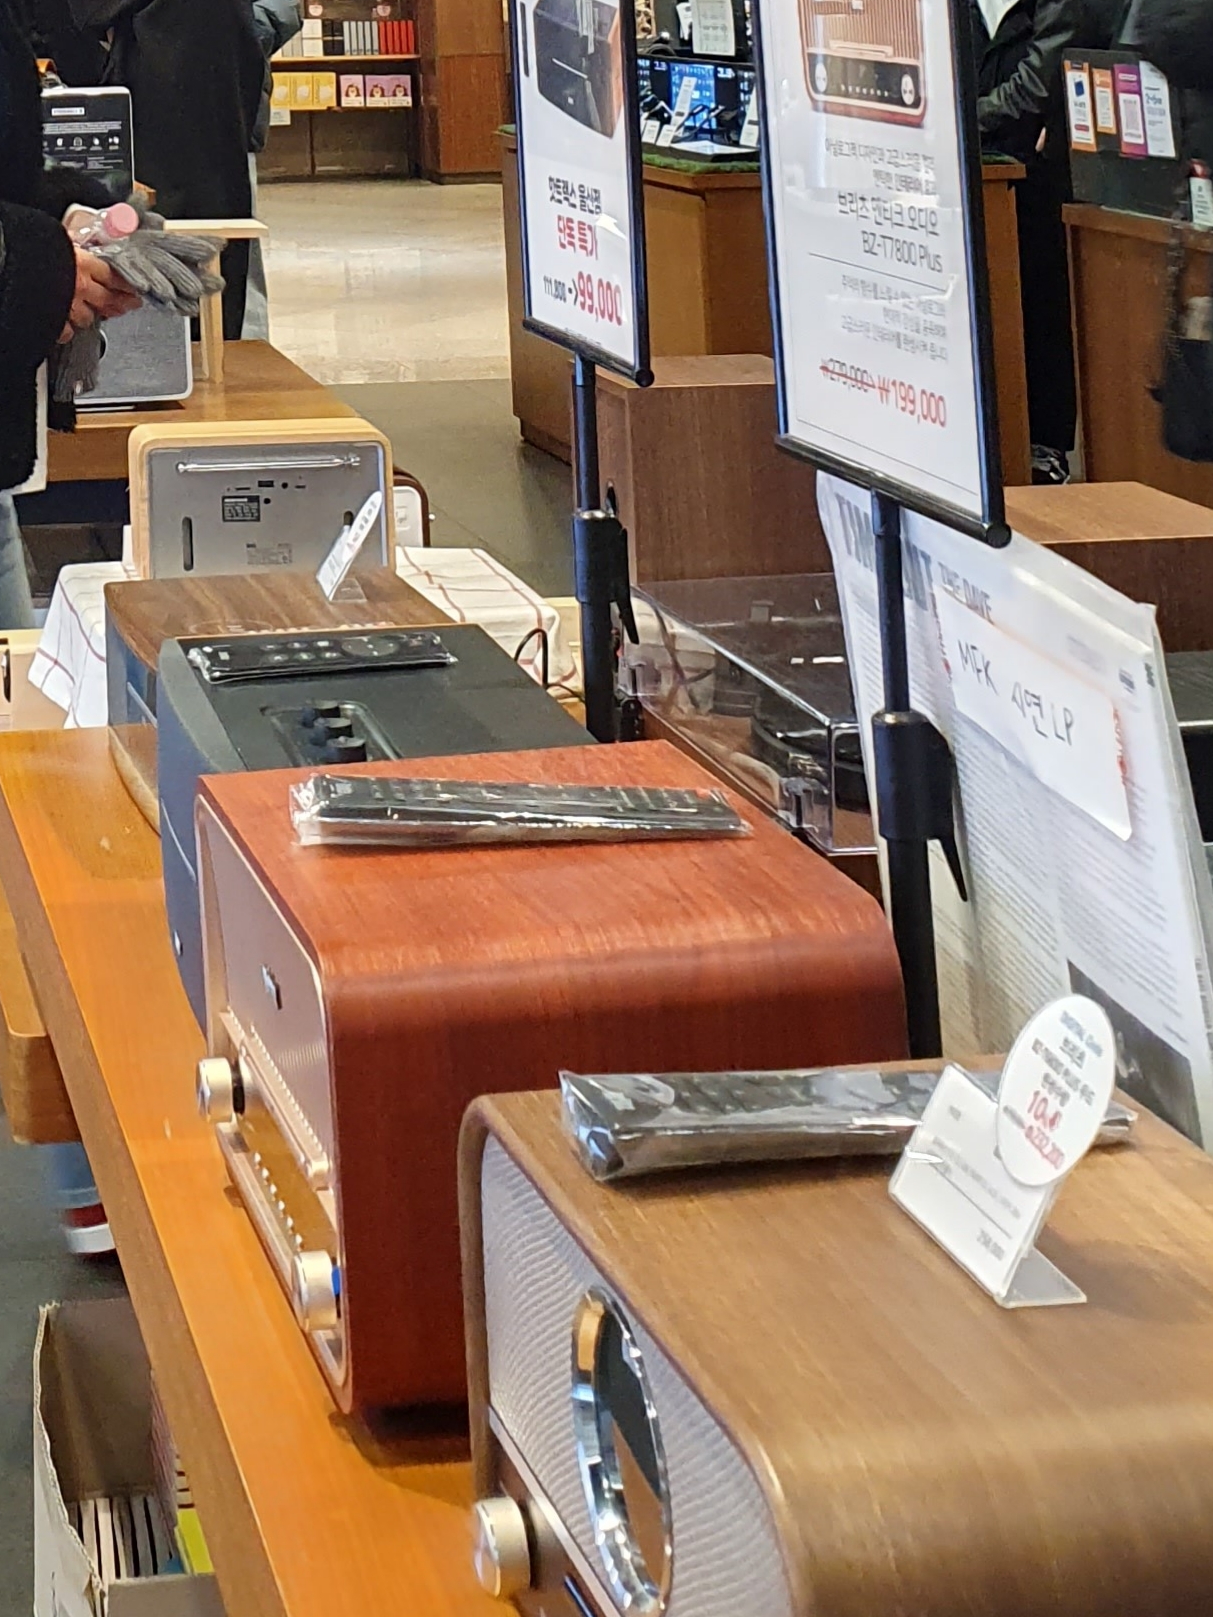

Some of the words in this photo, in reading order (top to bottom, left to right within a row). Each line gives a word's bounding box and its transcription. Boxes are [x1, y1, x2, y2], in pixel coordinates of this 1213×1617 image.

[548, 175, 577, 209] 핫트랙스
[578, 184, 603, 216] 울산점
[838, 190, 870, 221] 브리츠
[907, 205, 940, 237] 오디오
[557, 214, 576, 254] 단독
[577, 219, 599, 261] 특가
[861, 230, 917, 266] BZ-T7800
[918, 244, 944, 273] Plus
[1050, 702, 1075, 746] LP
